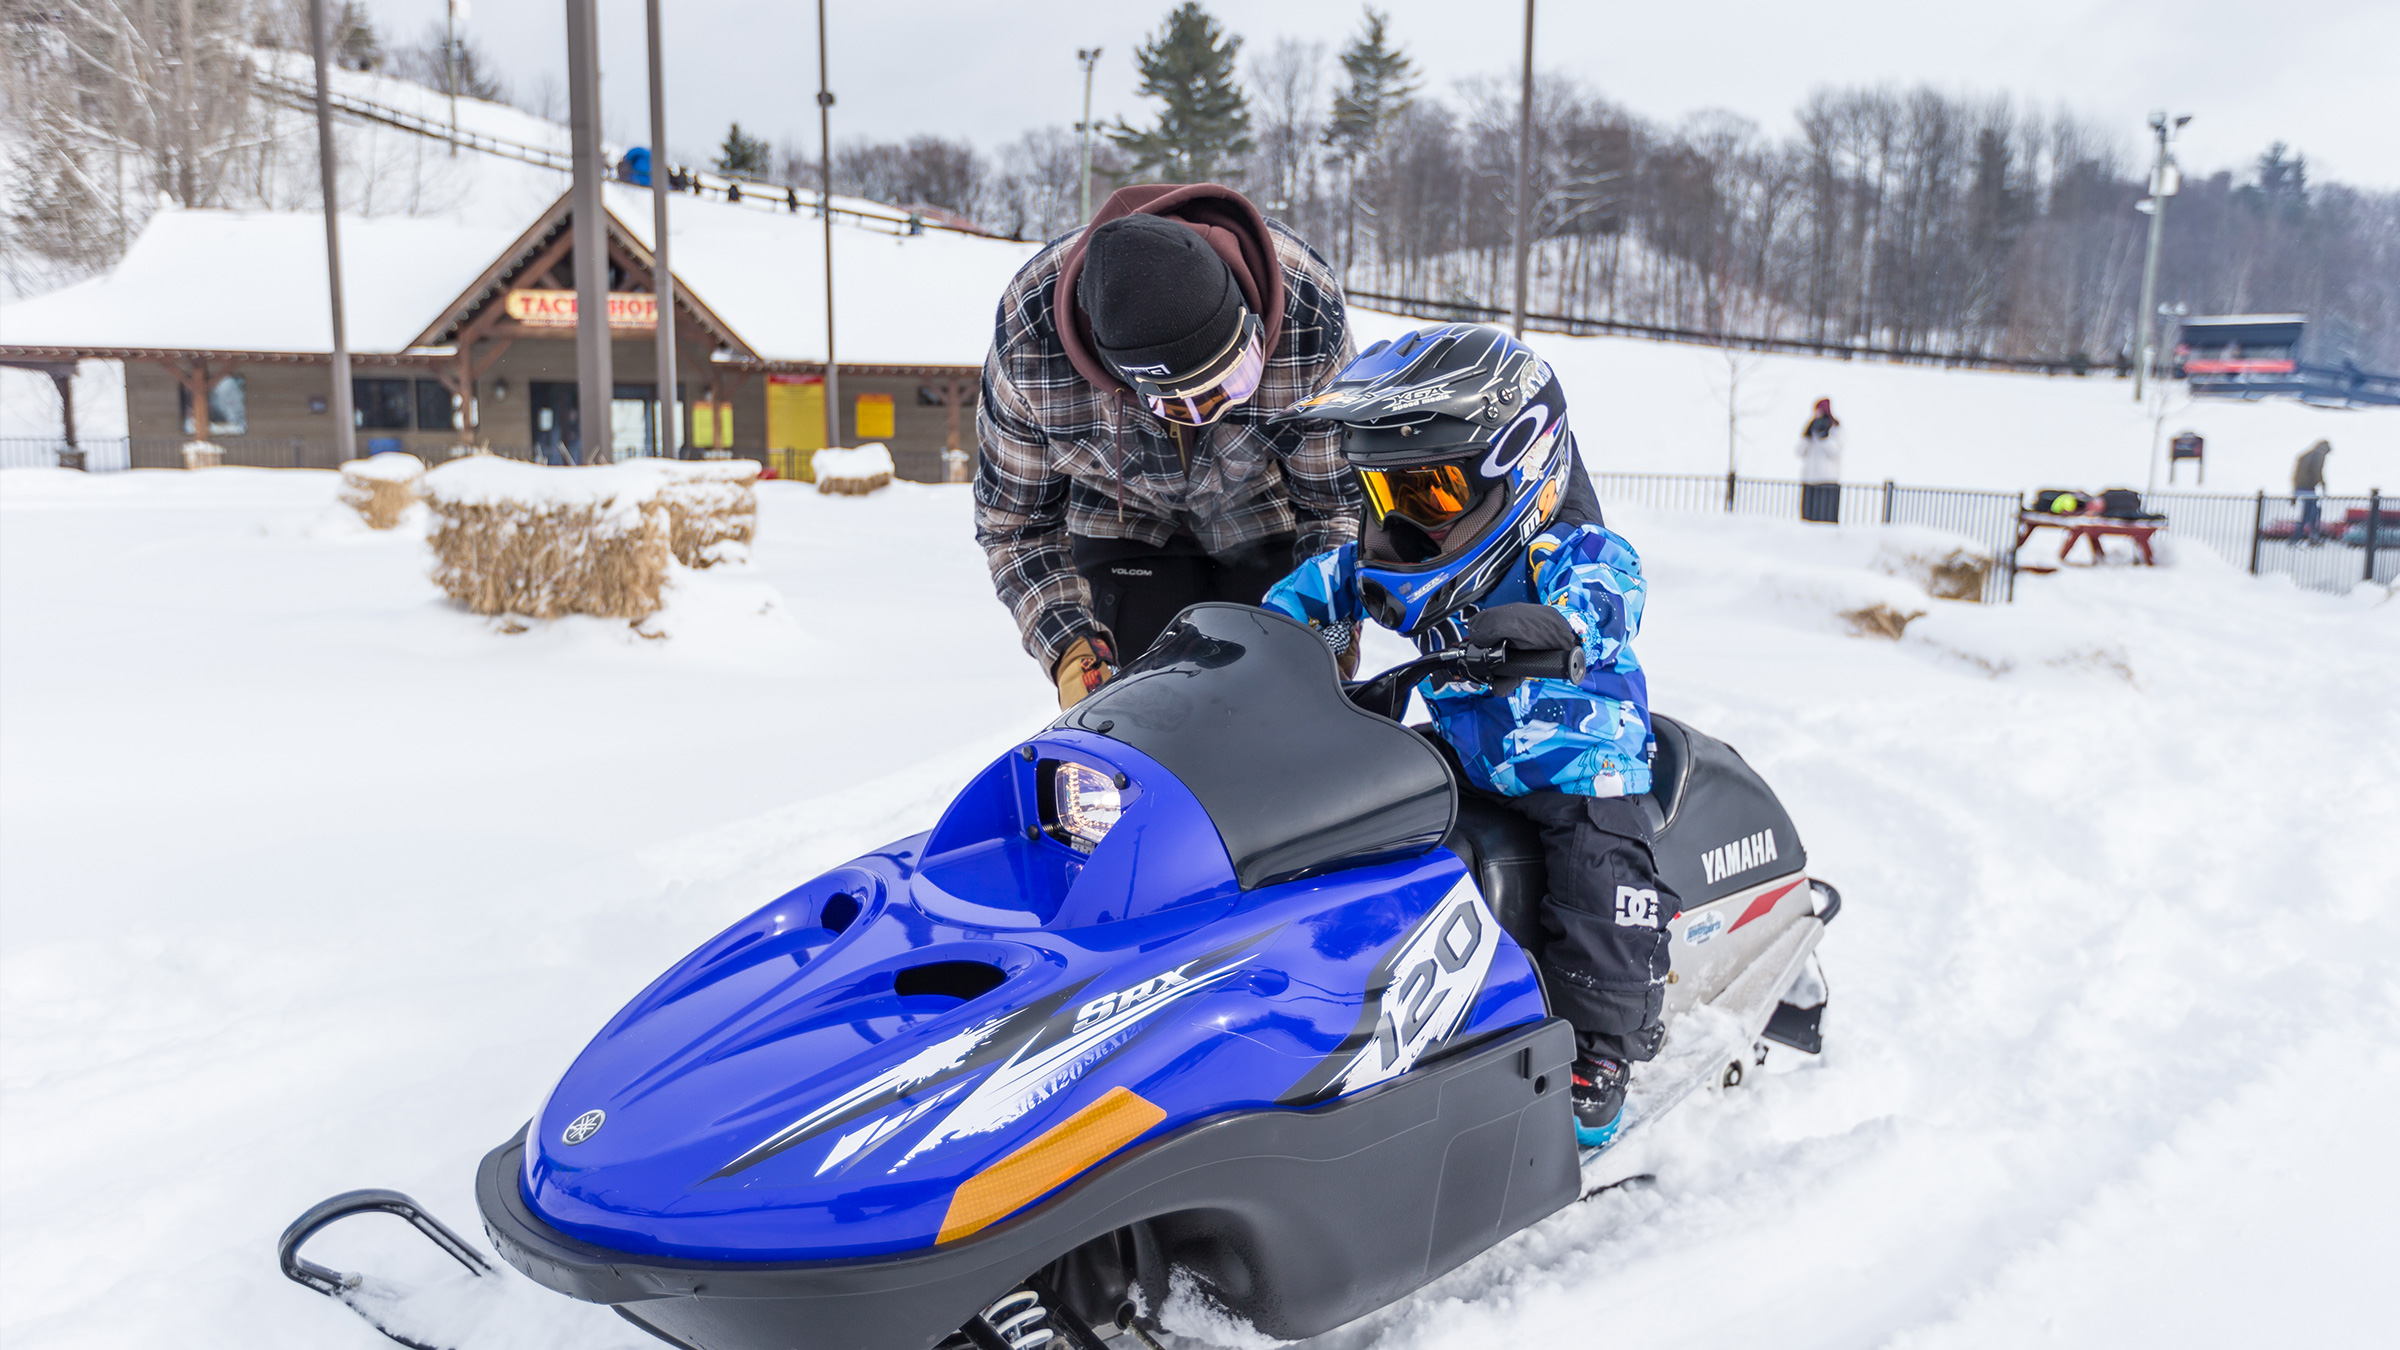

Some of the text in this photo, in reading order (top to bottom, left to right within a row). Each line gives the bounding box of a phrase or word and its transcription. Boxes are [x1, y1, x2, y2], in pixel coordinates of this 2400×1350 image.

[1111, 567, 1153, 581] VOLCOM
[1701, 828, 1778, 885] YAMAHA
[1615, 885, 1659, 929] DC
[1072, 959, 1200, 1034] SRX
[1375, 900, 1483, 1072] 120
